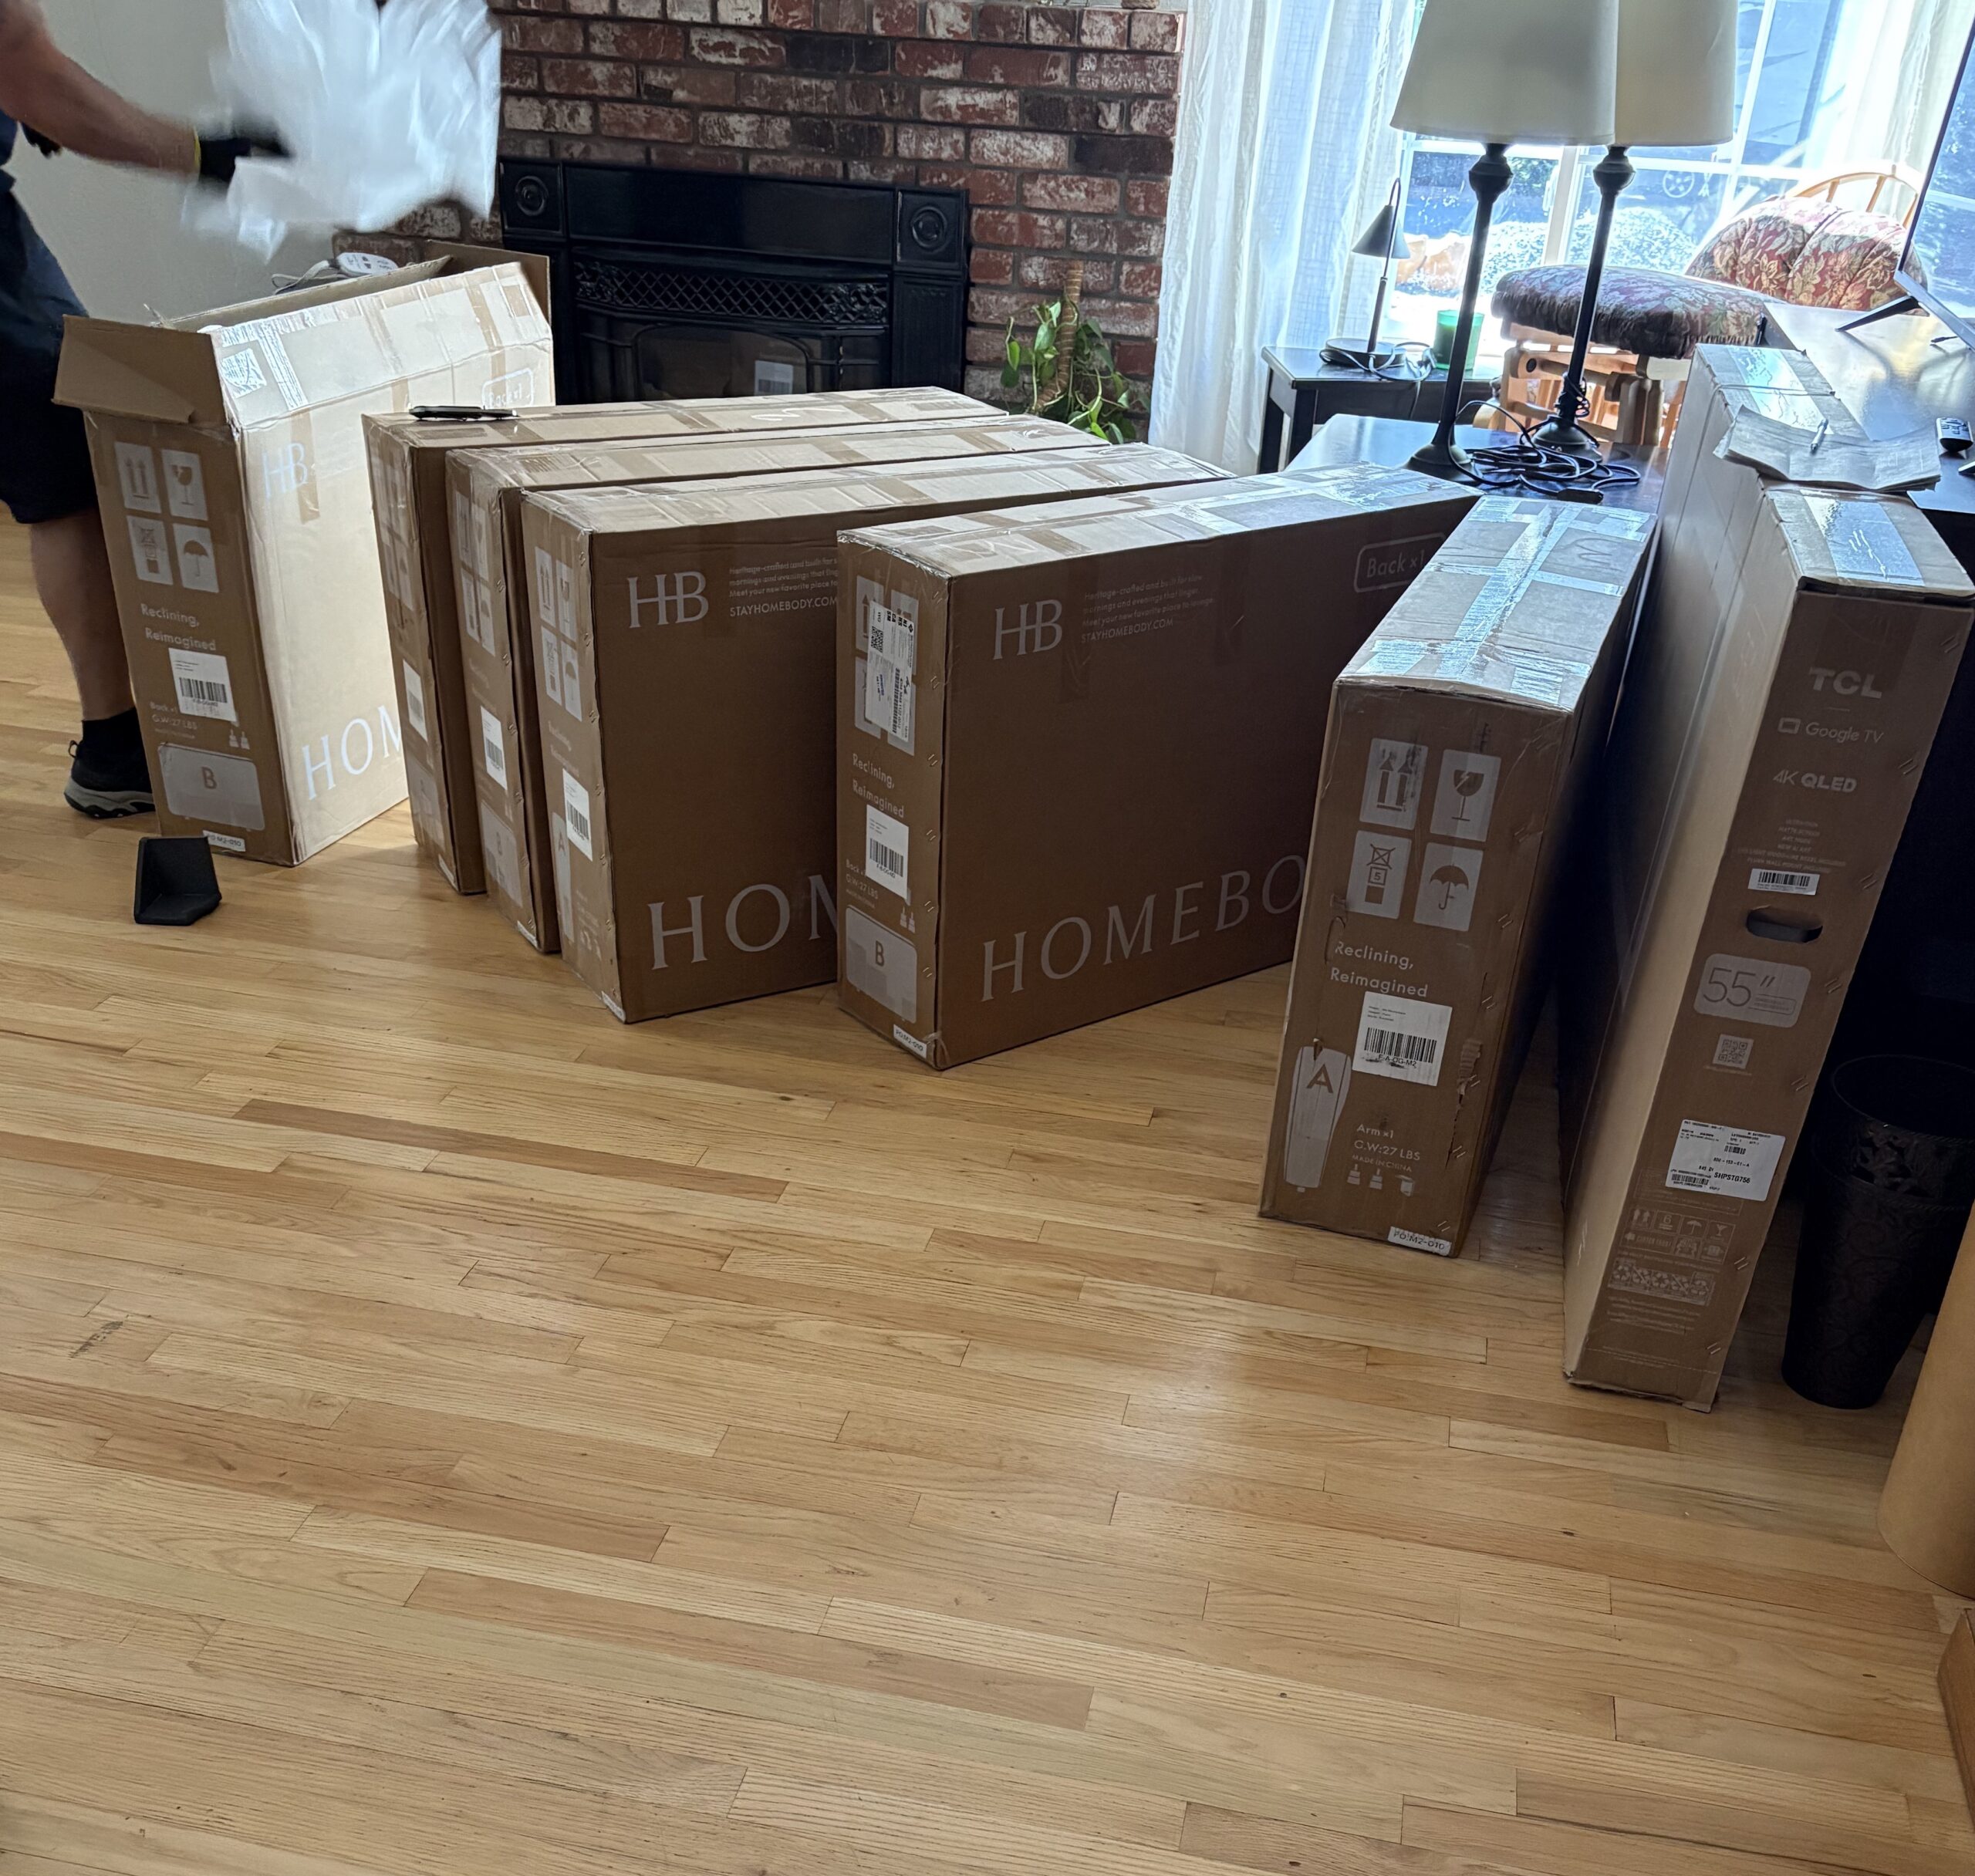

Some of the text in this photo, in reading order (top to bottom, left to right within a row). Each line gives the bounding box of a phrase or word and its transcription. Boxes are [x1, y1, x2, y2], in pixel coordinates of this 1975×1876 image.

[262, 443, 309, 502] HB
[1367, 549, 1425, 579] Back x1
[627, 571, 709, 628] HB
[729, 589, 748, 598] Meet
[749, 587, 765, 598] your
[781, 582, 810, 592] favorite
[810, 580, 829, 591] place
[140, 603, 199, 627] Reclining,
[730, 596, 837, 618] STAYHOMEBODY.COM
[1102, 616, 1117, 627] your
[1119, 612, 1133, 622] new
[1133, 607, 1161, 619] favorite
[1163, 603, 1181, 615] place
[145, 626, 216, 651] Reimagined
[993, 599, 1062, 660] HB
[1081, 617, 1173, 645] STAYHOMEBODY.COM
[1809, 666, 1882, 699] TCL
[1805, 721, 1885, 744] Google TV
[201, 766, 217, 790] B
[852, 753, 895, 789] Reclining,
[1773, 769, 1858, 793] 4K QLED
[852, 778, 904, 818] Reimagined
[981, 854, 1307, 1002] HOMEBO
[875, 940, 885, 967] B
[1335, 941, 1414, 970] Reclining,
[1331, 967, 1428, 997] Reimagined
[1306, 1064, 1334, 1094] A
[1356, 1123, 1380, 1136] Arm
[1352, 1154, 1413, 1173] MADE IN CHINA
[1399, 1148, 1420, 1162] LBS
